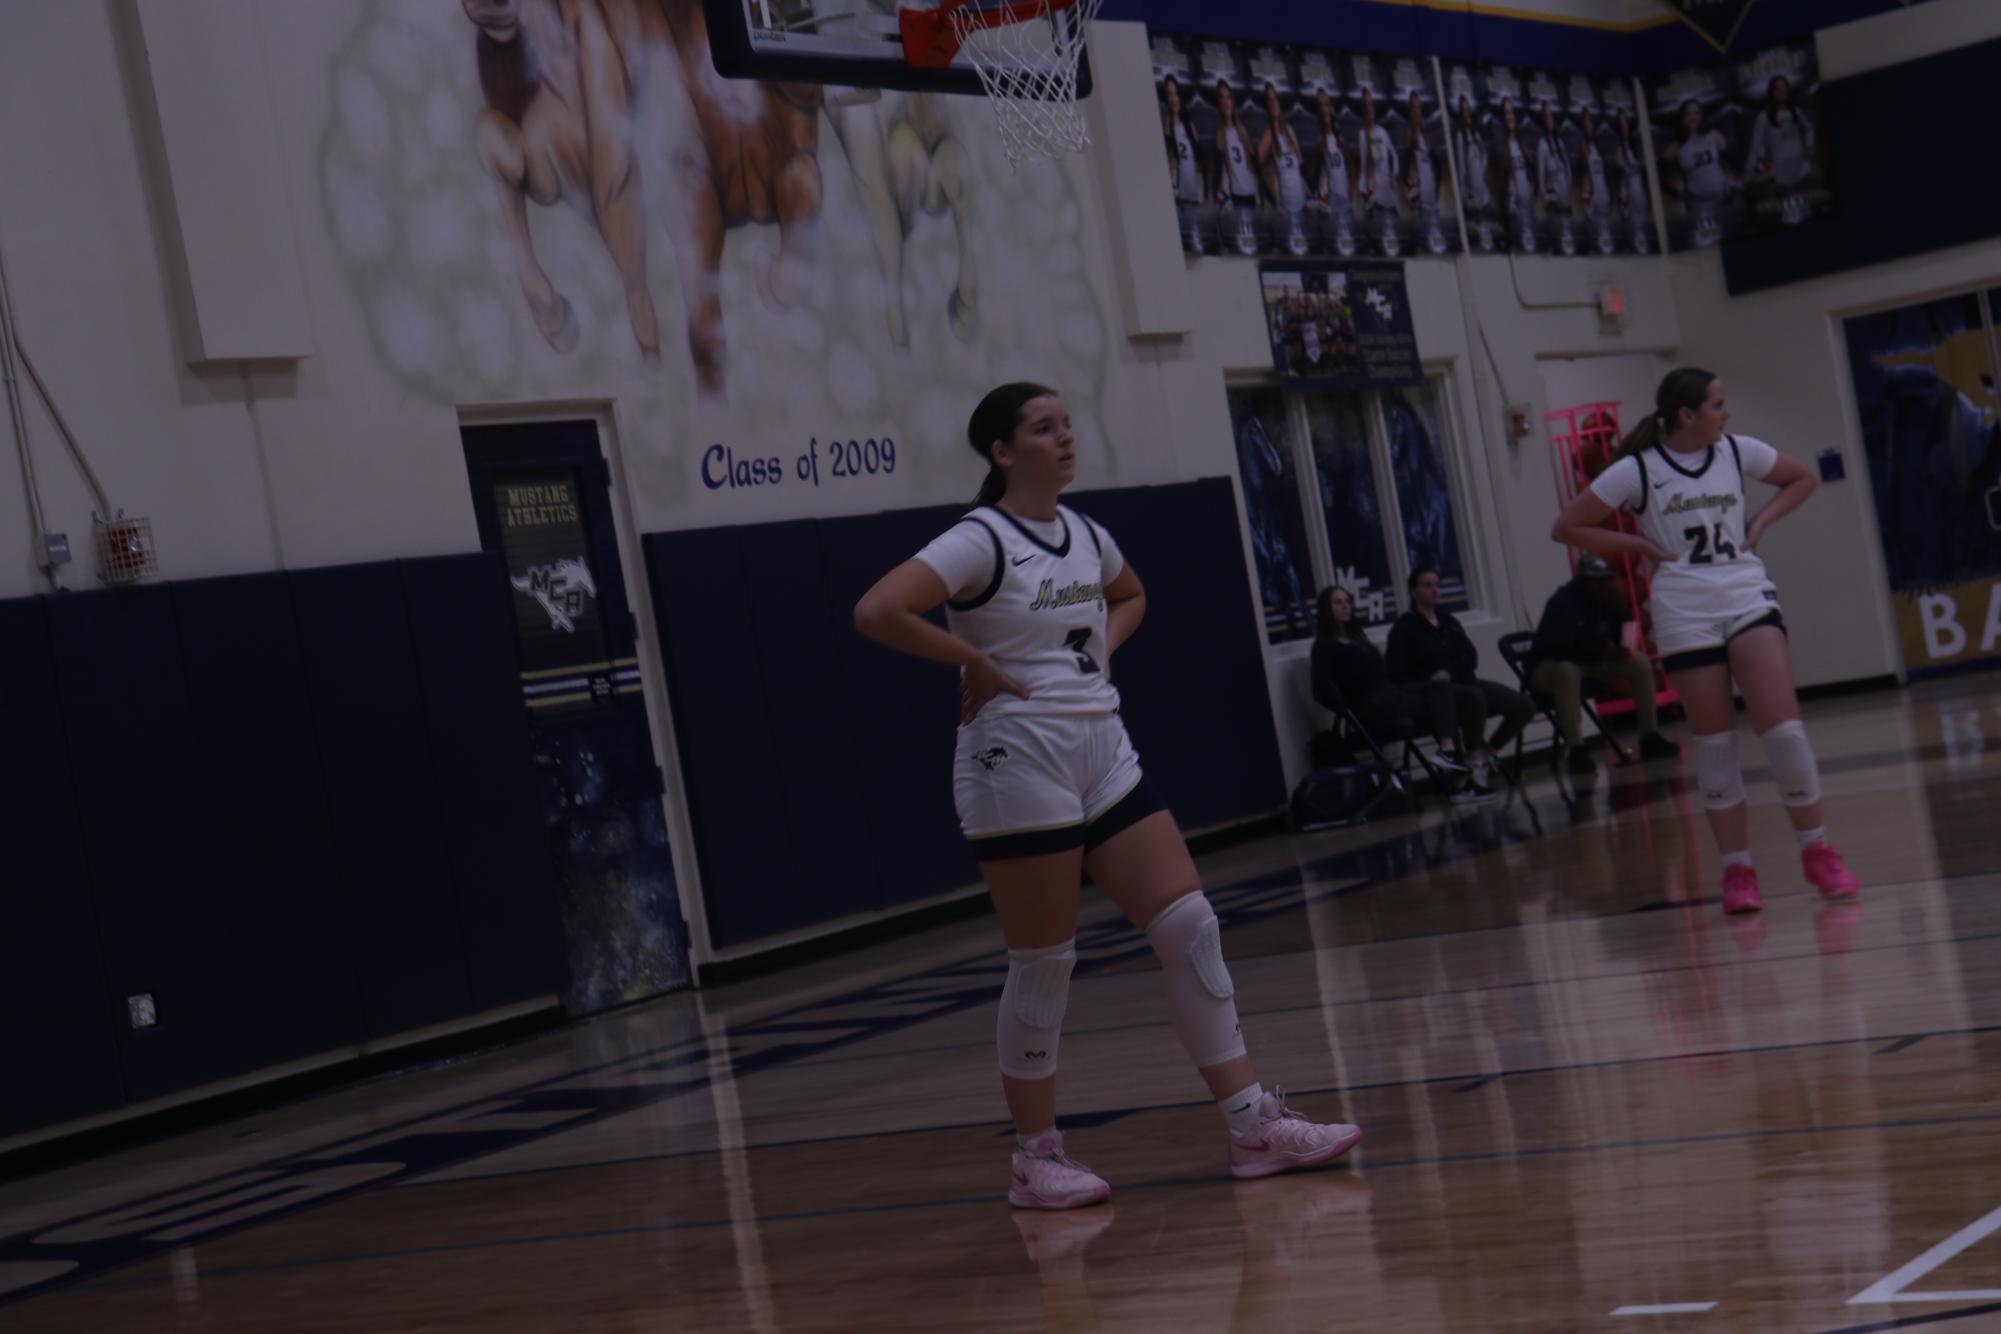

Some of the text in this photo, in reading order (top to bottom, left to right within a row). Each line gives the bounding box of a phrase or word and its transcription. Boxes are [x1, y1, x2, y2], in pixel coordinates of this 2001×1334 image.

[1231, 145, 1242, 164] 3
[701, 436, 896, 490] Class of 2009
[507, 484, 569, 506] MUSTANG
[506, 503, 577, 527] ATHLETICS
[529, 567, 583, 614] MCA
[1063, 626, 1101, 675] 3
